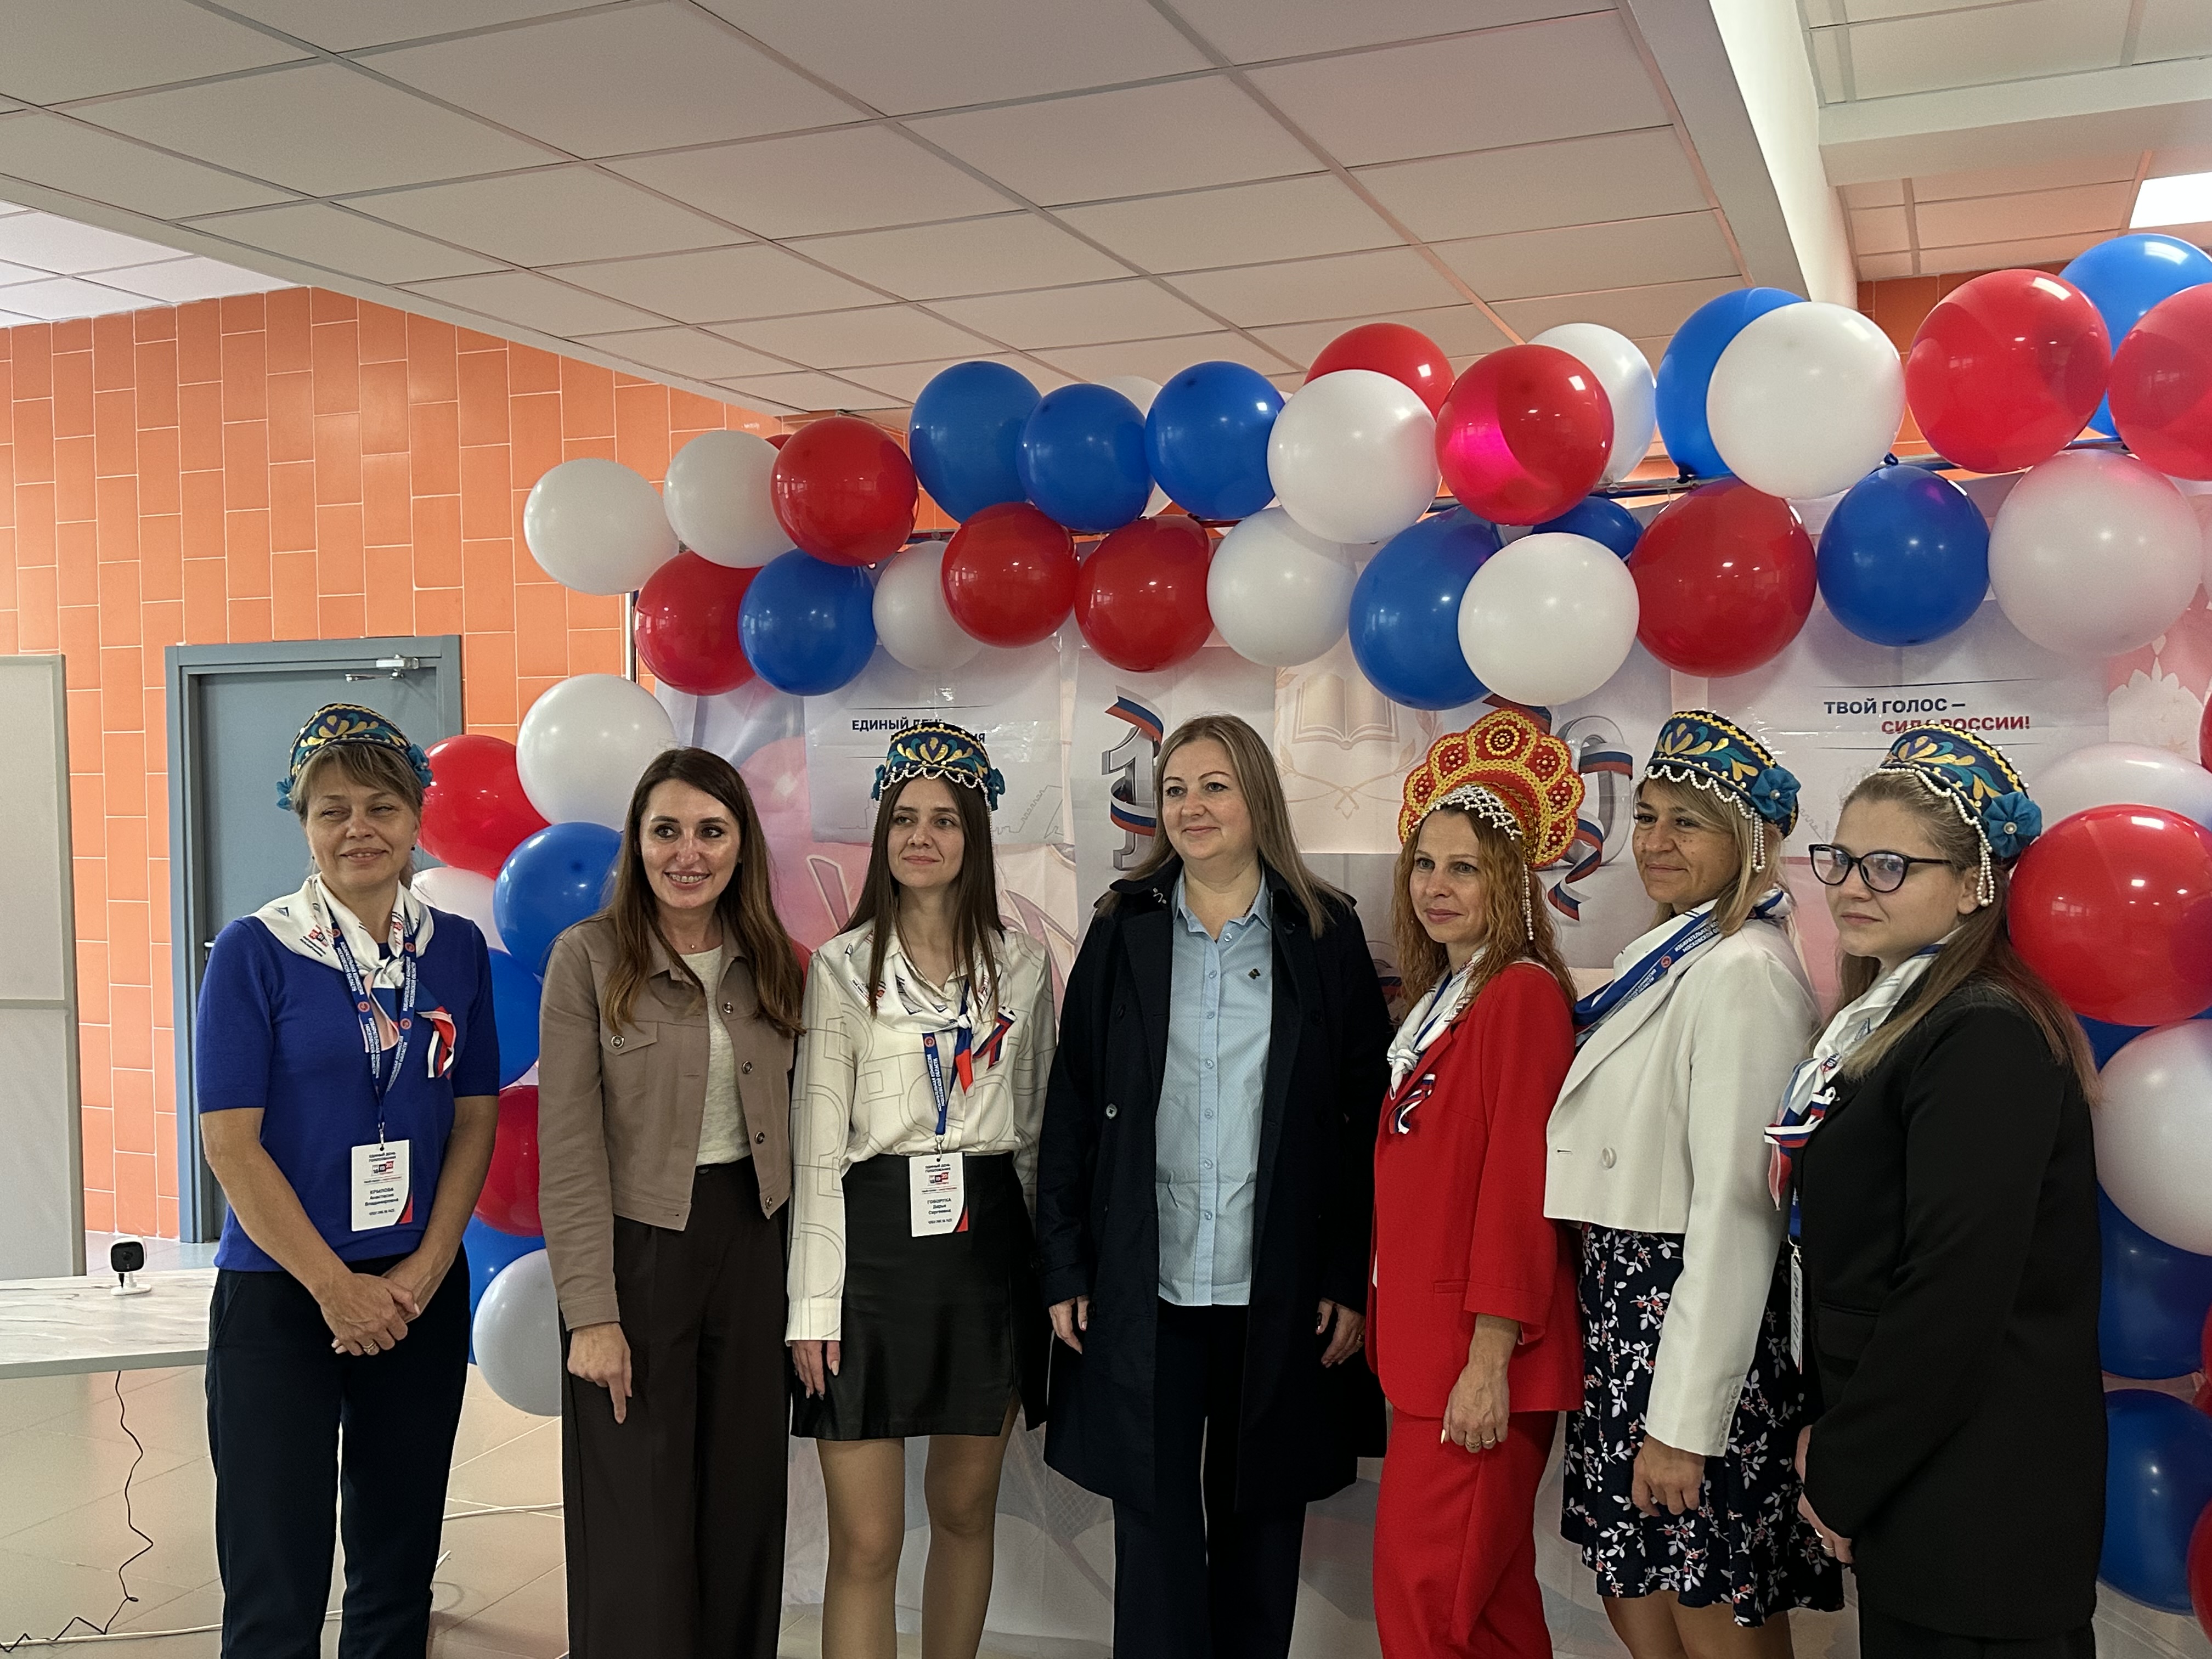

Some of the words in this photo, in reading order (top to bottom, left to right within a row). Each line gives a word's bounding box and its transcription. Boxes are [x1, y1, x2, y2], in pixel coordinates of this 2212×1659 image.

[1823, 697, 1877, 714] ТВОЙ
[1882, 697, 1948, 713] ГОЛОС
[851, 716, 909, 732] ЕДИНЫЙ
